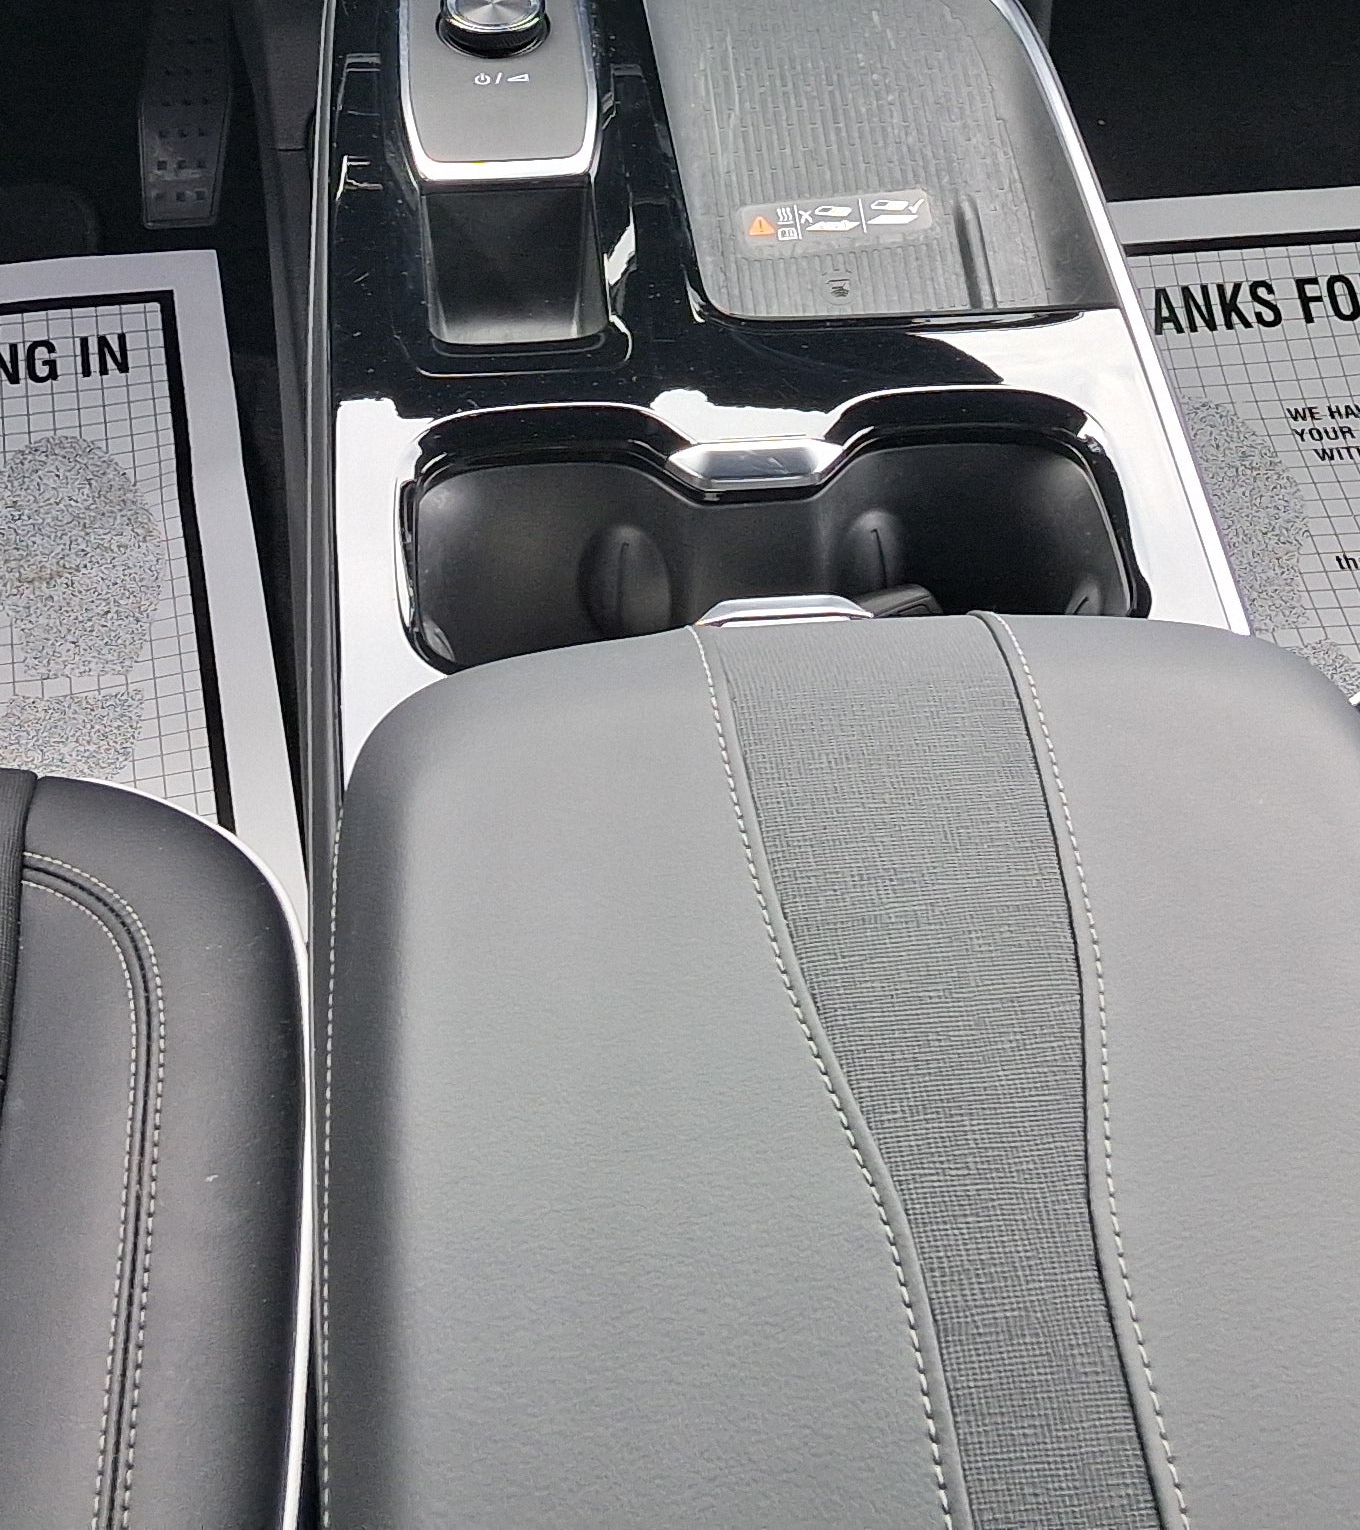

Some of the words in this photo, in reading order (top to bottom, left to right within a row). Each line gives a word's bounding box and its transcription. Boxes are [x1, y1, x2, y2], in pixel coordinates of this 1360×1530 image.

[1154, 280, 1283, 336] ANKS
[79, 332, 130, 378] IN
[1286, 406, 1323, 422] WE
[1291, 426, 1356, 443] YOUR
